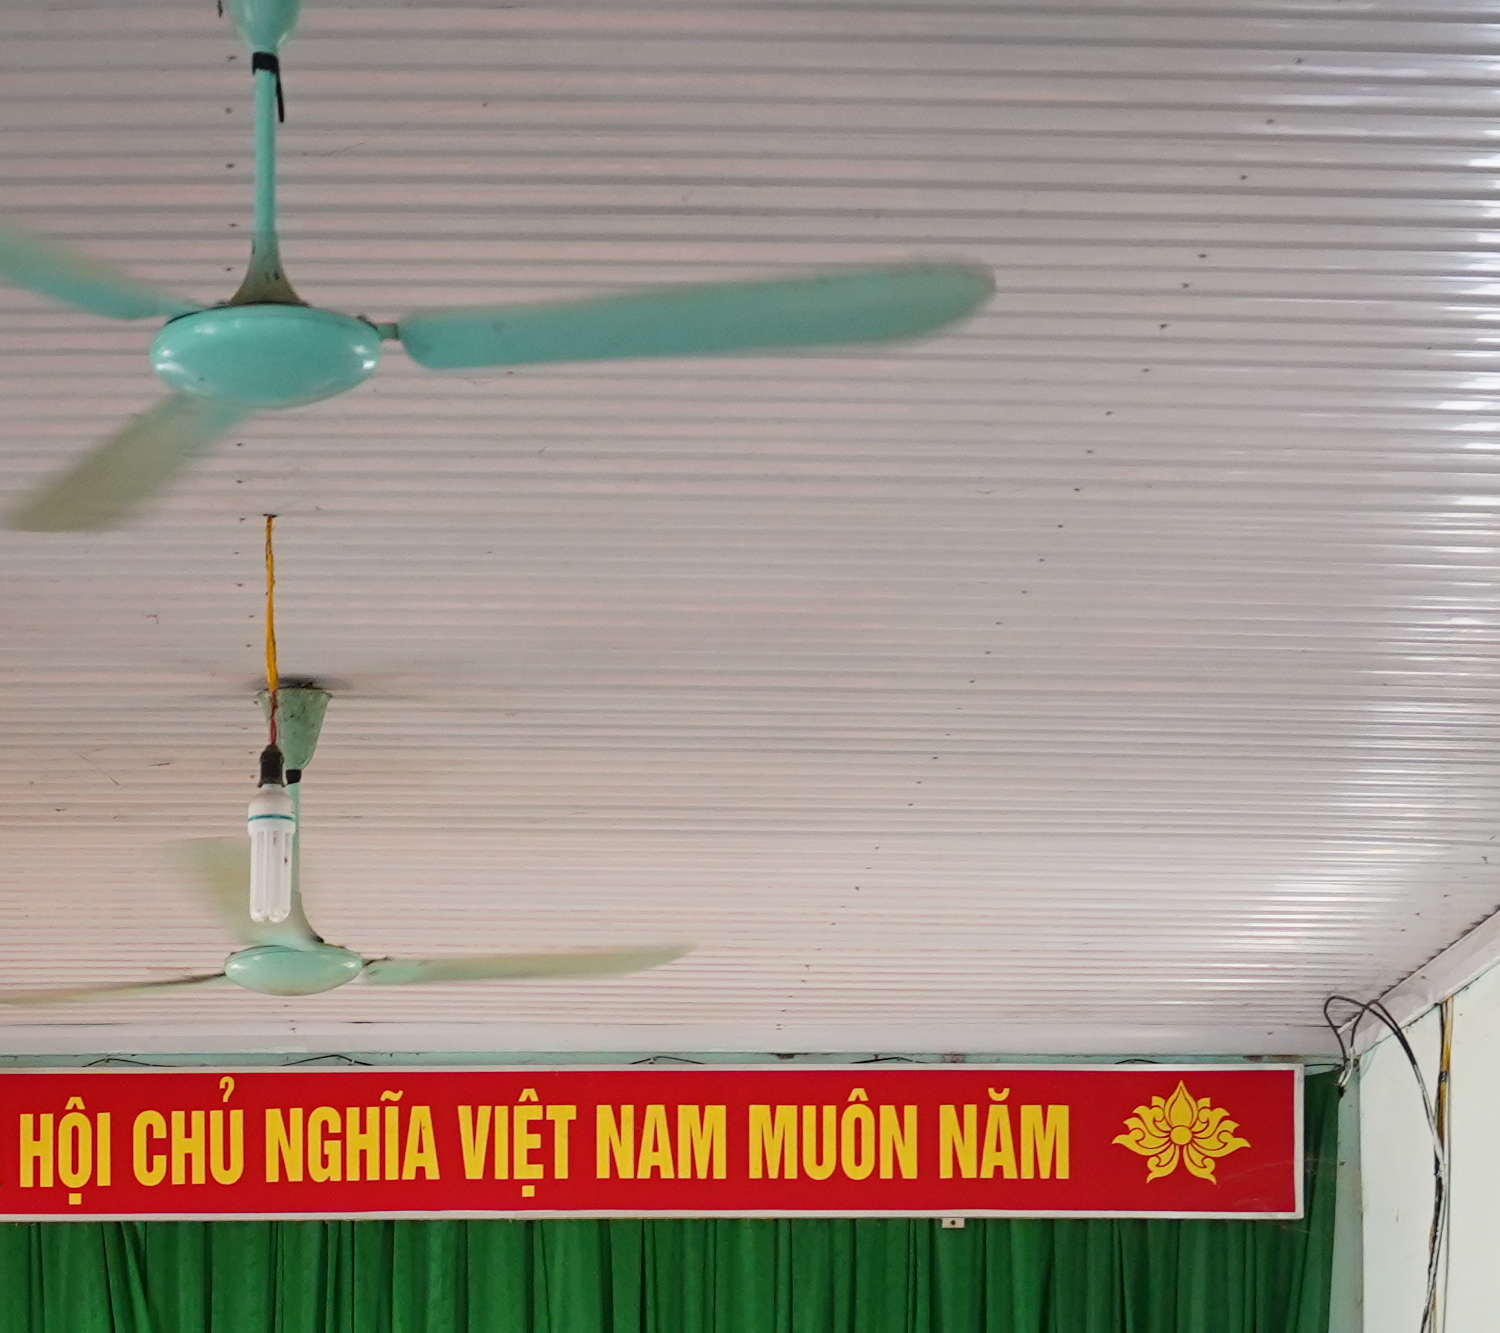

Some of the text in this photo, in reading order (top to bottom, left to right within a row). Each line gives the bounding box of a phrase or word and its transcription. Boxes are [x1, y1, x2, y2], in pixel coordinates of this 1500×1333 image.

[19, 1096, 111, 1205] HỘI
[132, 1076, 244, 1187] CHỦ
[265, 1089, 441, 1183] NGHĨA
[457, 1088, 577, 1198] VIỆT
[596, 1104, 727, 1180] NAM
[748, 1087, 918, 1181] MUÔN
[939, 1087, 1070, 1180] NĂM
